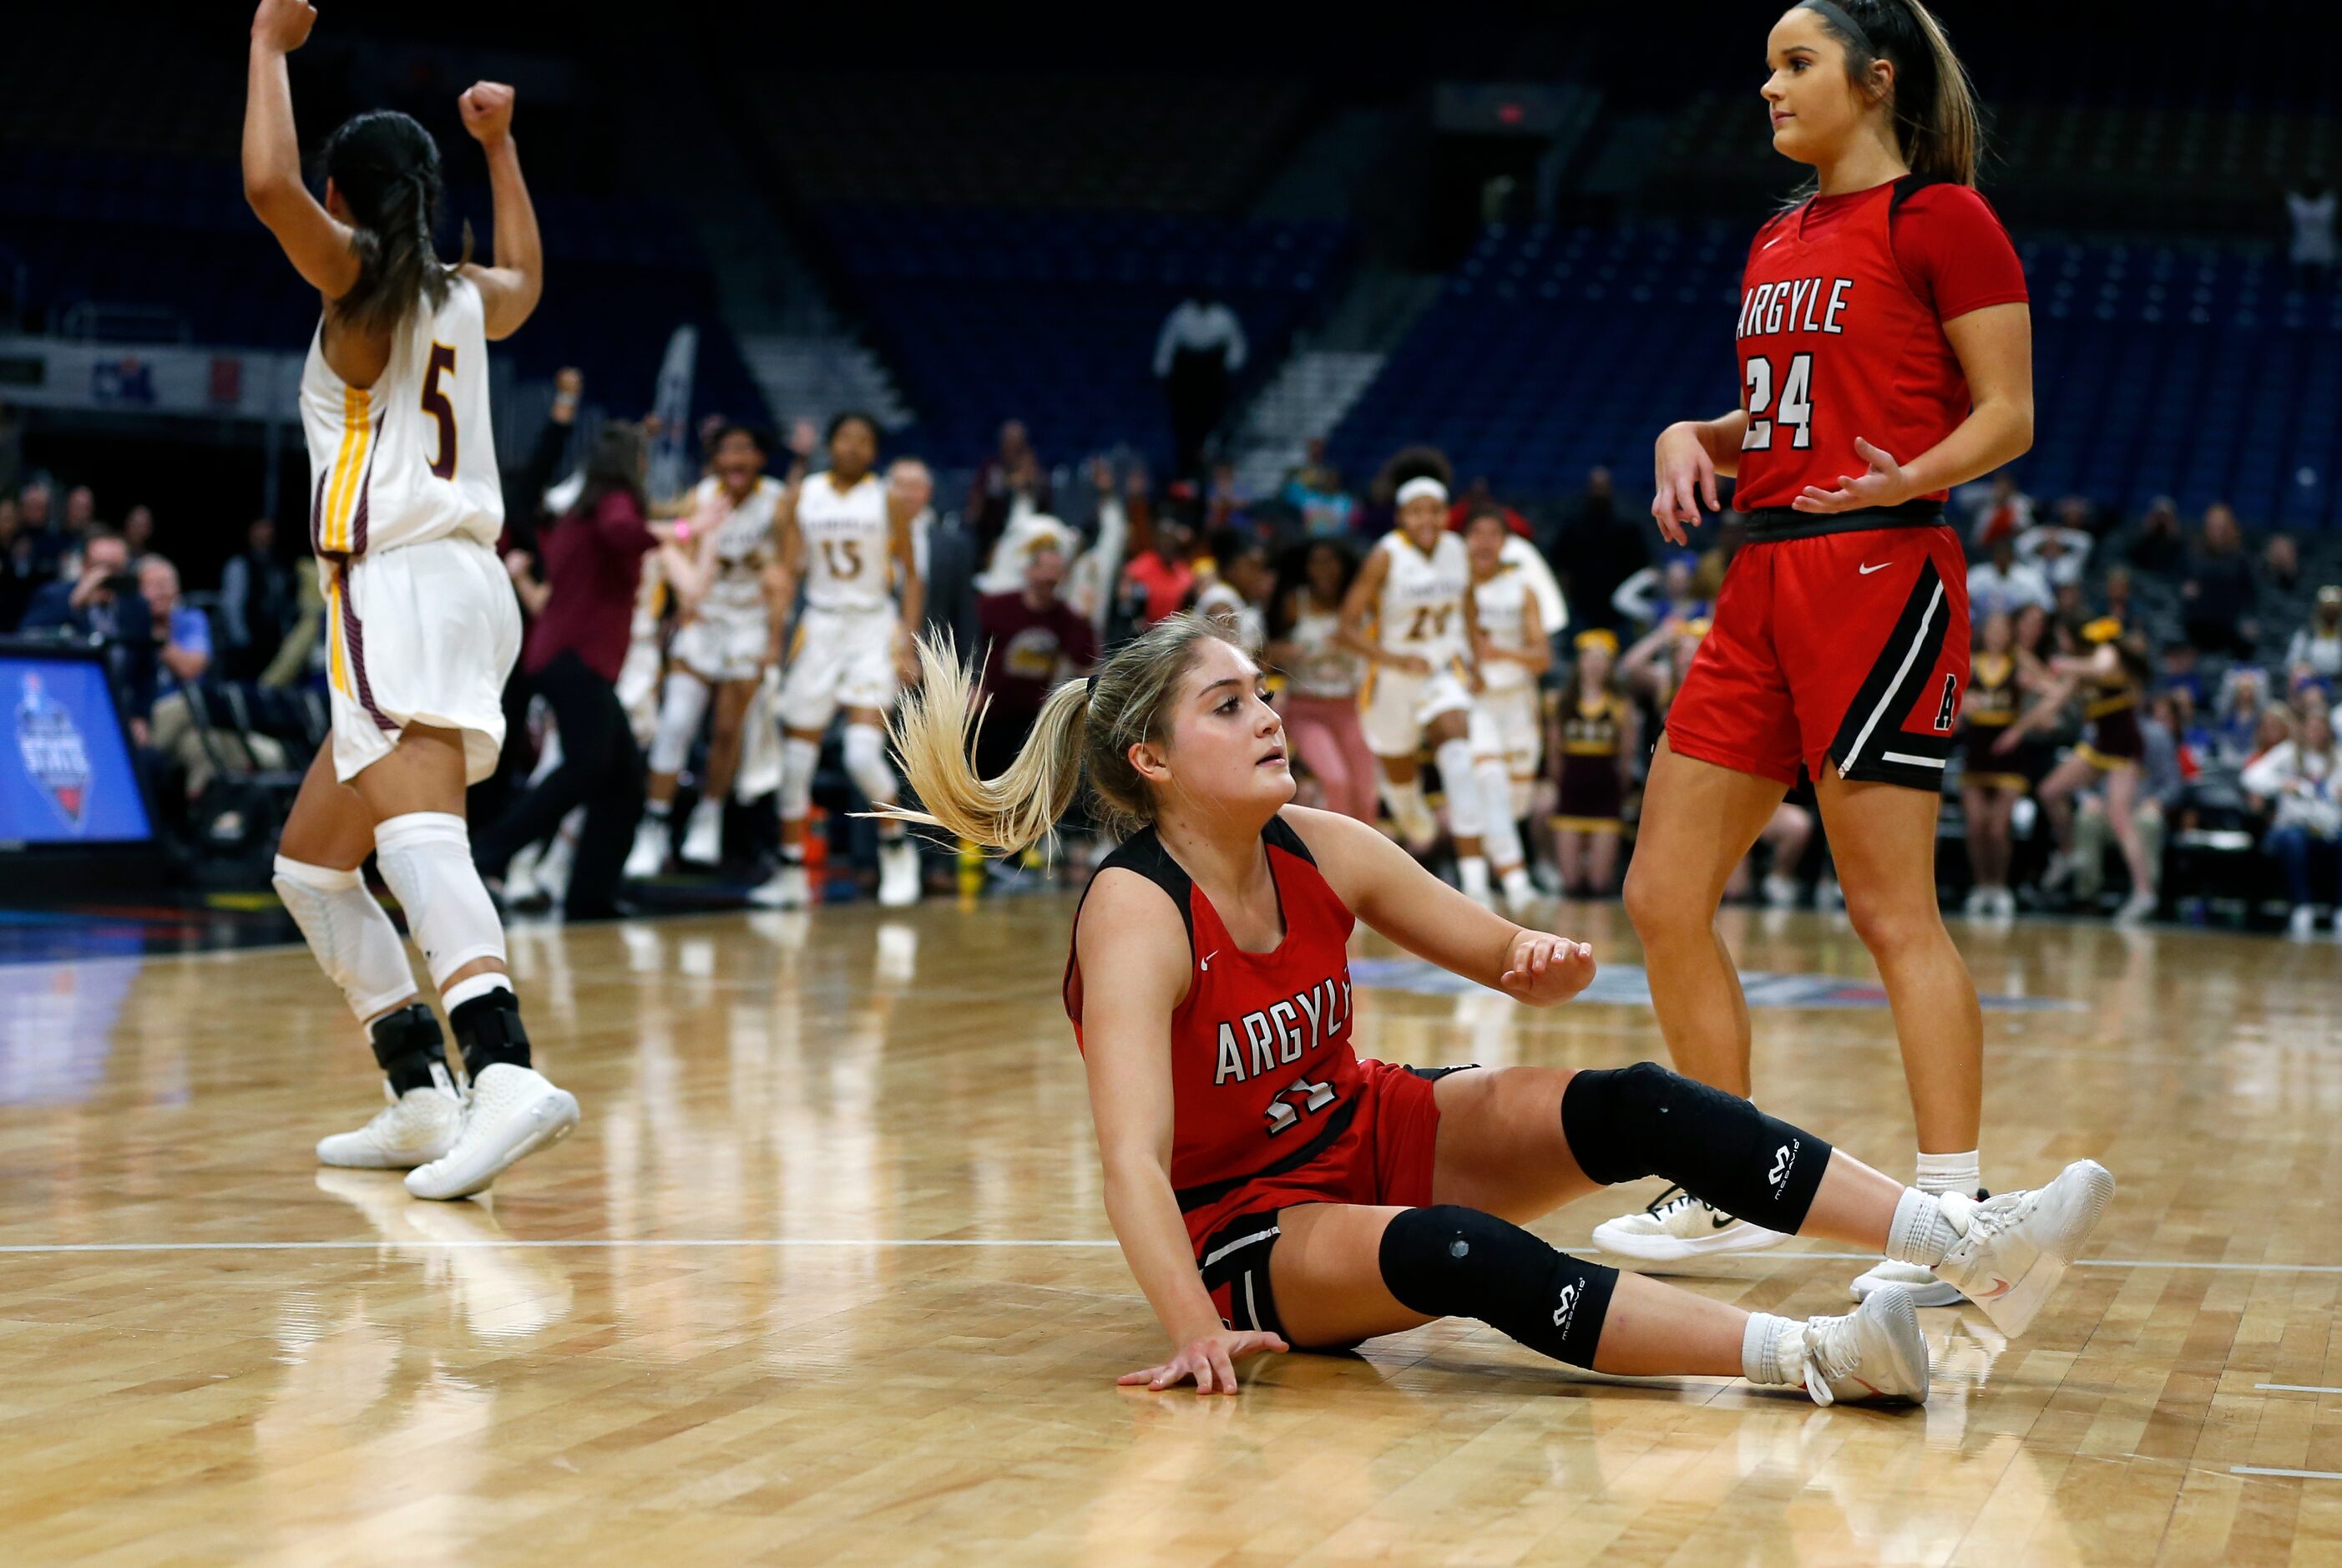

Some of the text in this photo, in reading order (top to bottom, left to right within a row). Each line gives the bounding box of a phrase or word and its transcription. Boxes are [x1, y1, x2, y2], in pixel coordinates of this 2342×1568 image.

[1736, 272, 1854, 340] ARGYLE
[421, 338, 457, 483] 5
[1742, 351, 1813, 453] 24
[1934, 673, 1956, 731] A
